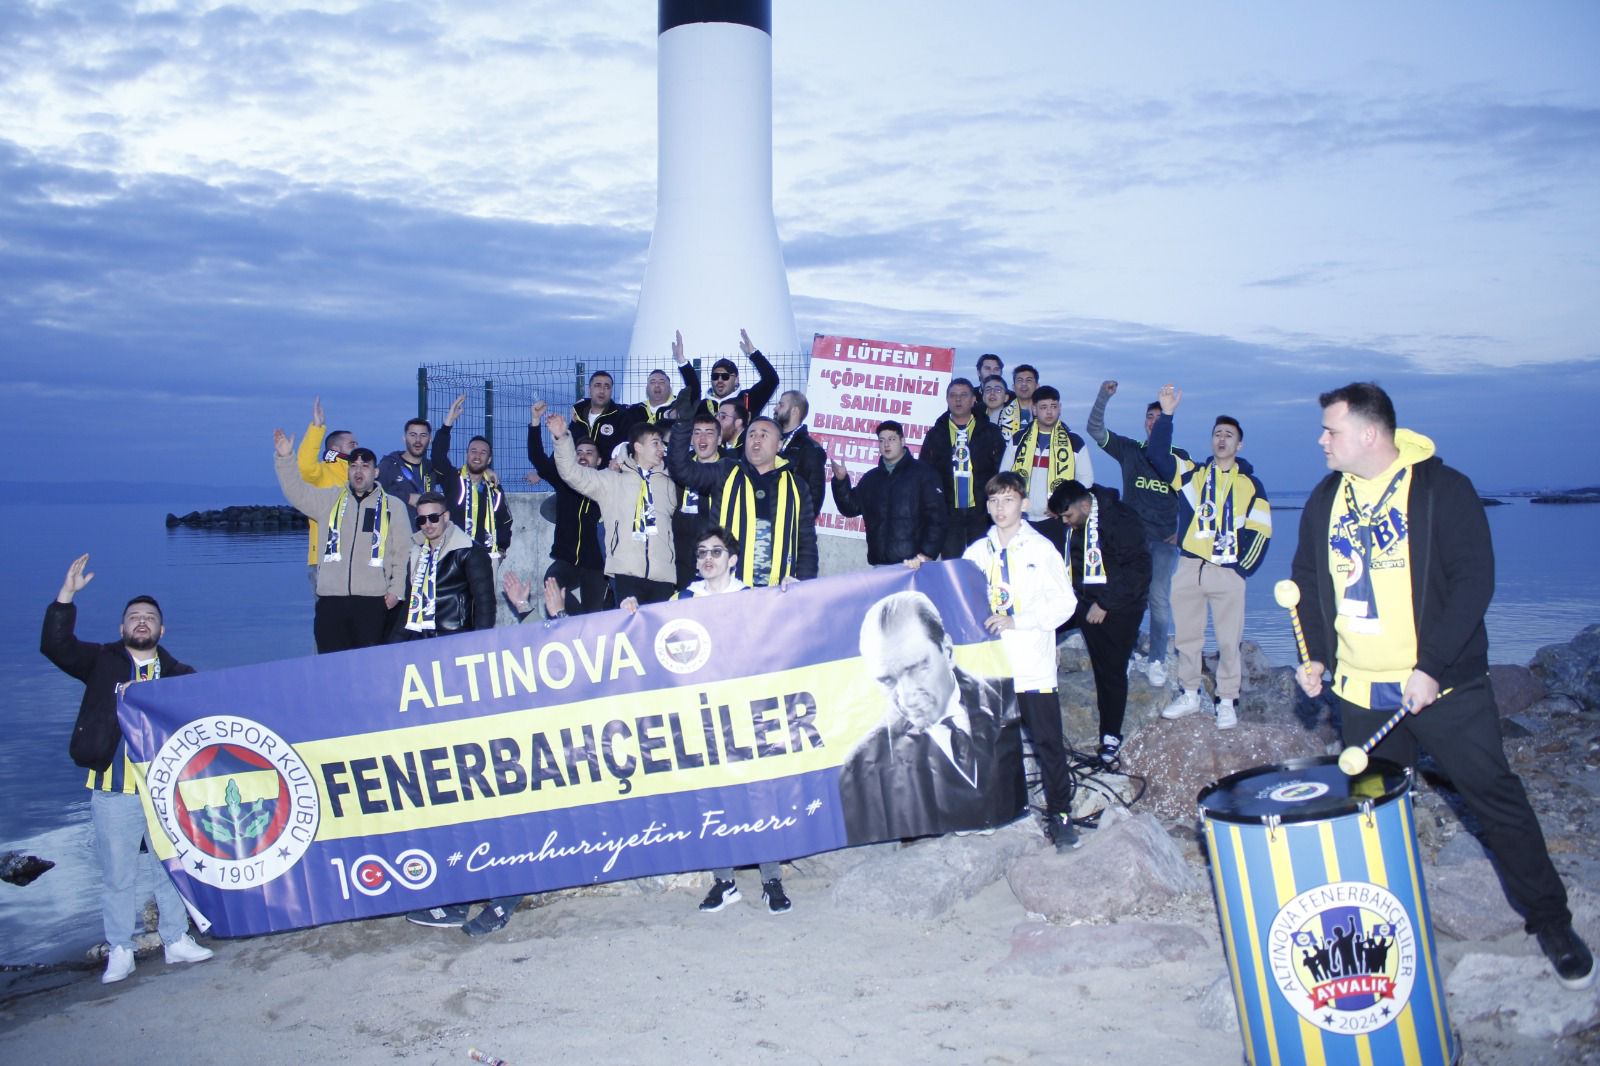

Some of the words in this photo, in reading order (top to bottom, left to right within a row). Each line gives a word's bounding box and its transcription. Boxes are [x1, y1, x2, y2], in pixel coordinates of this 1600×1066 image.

[847, 342, 919, 366] LÜTFEN
[840, 394, 913, 416] SAHİLDE
[834, 440, 880, 461] LÜTF
[1135, 476, 1169, 494] avea
[399, 631, 646, 712] ALTINOVA
[321, 691, 825, 819] FENERBAHÇELİLER
[214, 720, 277, 755] SPOR
[277, 752, 316, 843] KULÜBÜ
[699, 805, 797, 839] Feneri
[218, 860, 266, 884] 1907
[1273, 909, 1300, 991] ALTINOVA
[1298, 886, 1413, 977] FENERBAHÇELİLER
[1317, 978, 1388, 1001] AYVALIK
[1339, 1013, 1378, 1031] 2024
